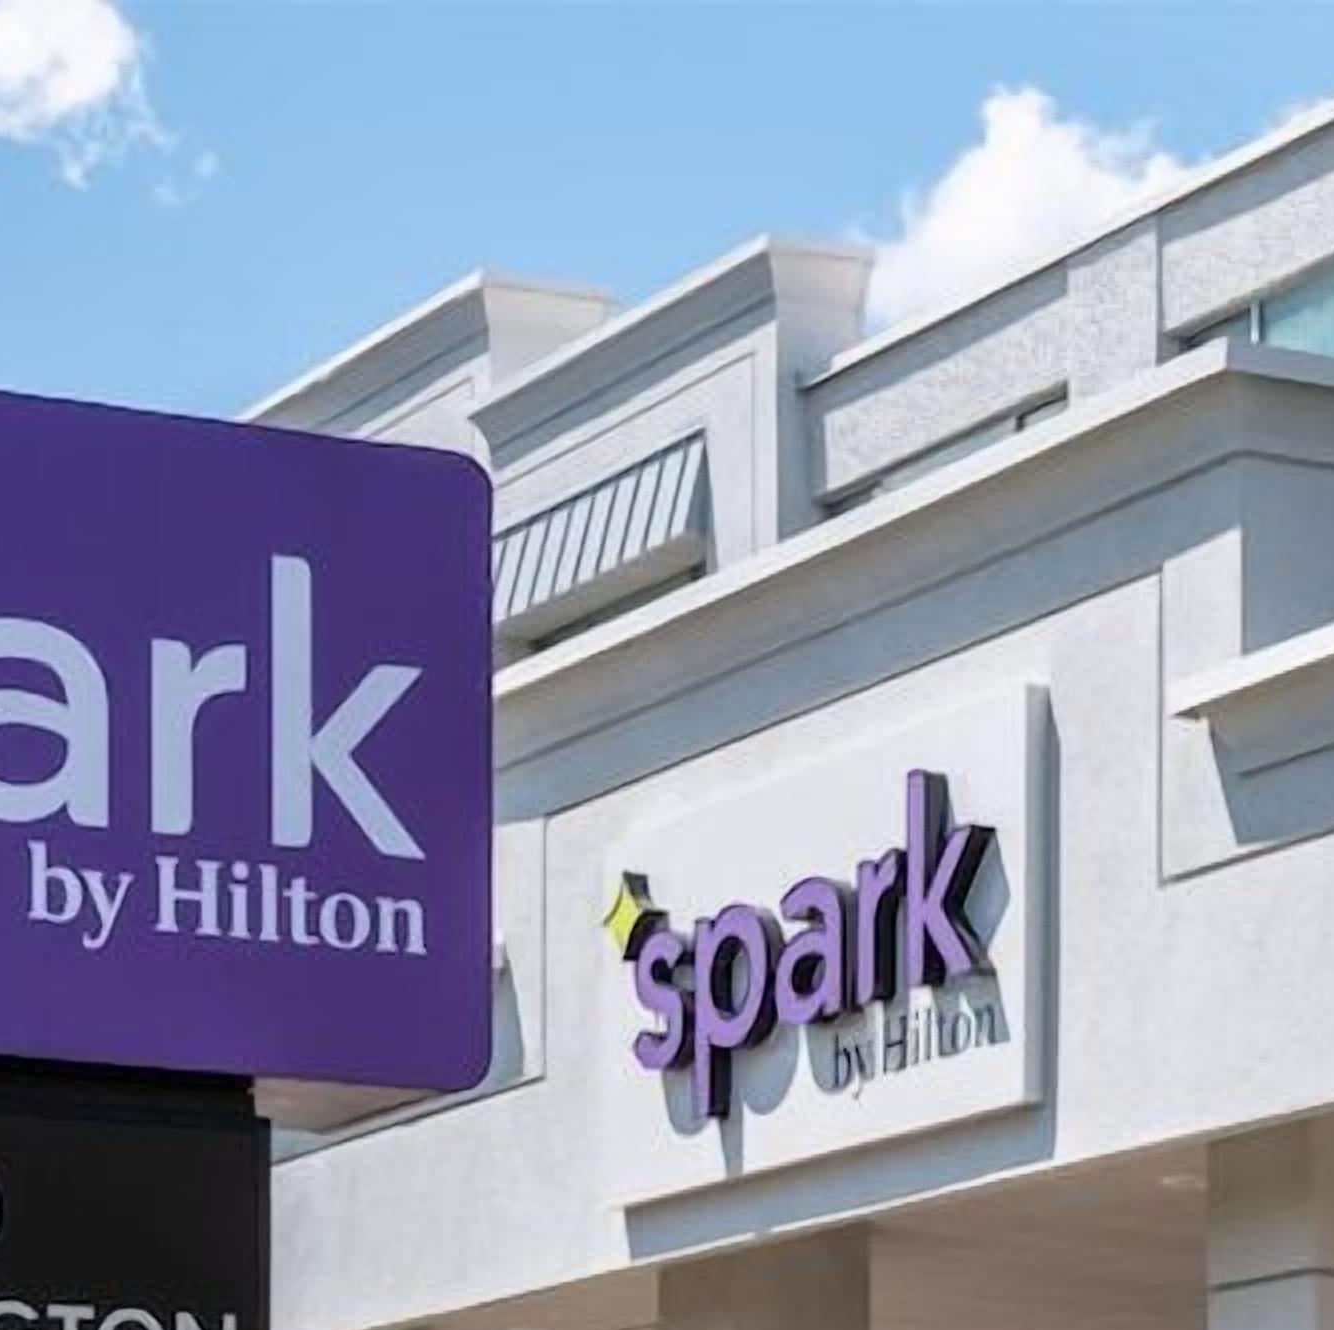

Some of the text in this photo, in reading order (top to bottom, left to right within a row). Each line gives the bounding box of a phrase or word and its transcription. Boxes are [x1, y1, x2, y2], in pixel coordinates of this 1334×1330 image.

[28, 840, 427, 955] by Hilton
[632, 769, 996, 1120] spark
[833, 1004, 998, 1100] by Hilton
